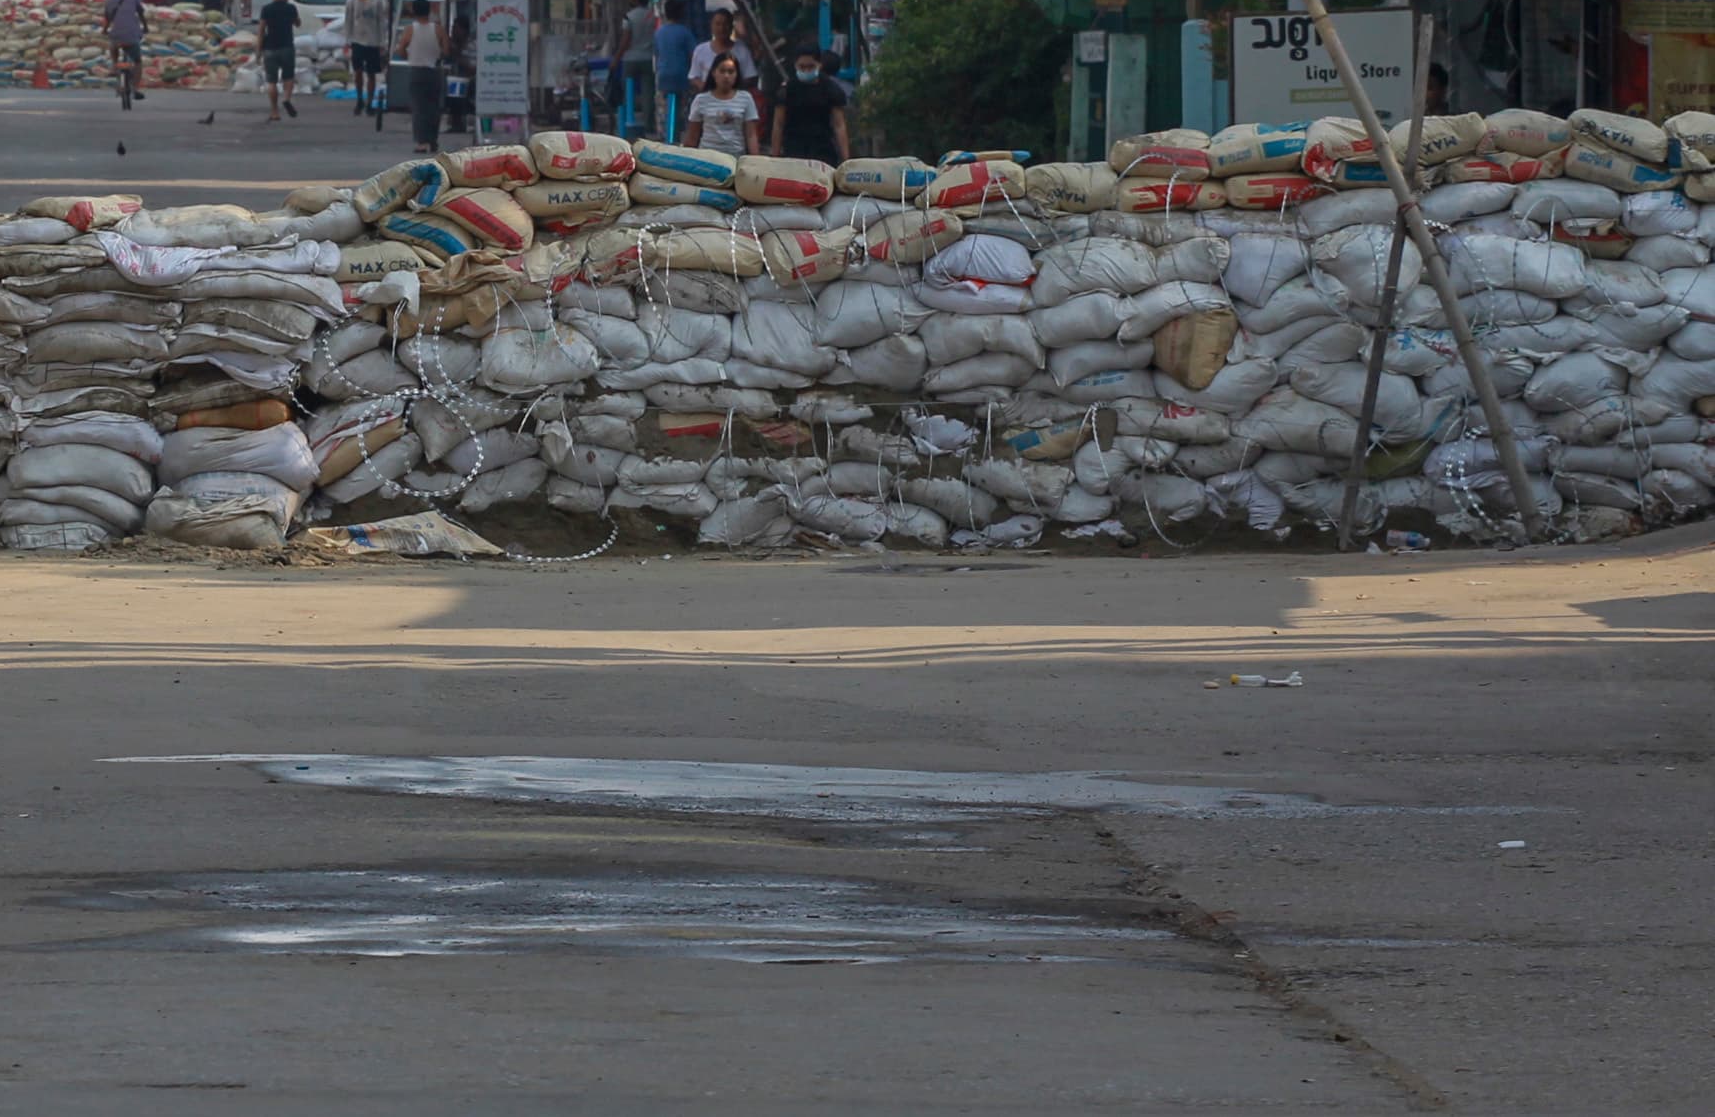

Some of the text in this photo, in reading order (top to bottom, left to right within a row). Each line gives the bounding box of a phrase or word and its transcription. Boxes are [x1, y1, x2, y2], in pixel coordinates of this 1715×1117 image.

[1306, 63, 1401, 82] Liqu Store
[1421, 136, 1458, 156] MAX
[548, 191, 583, 204] MAX
[350, 262, 385, 275] MAX
